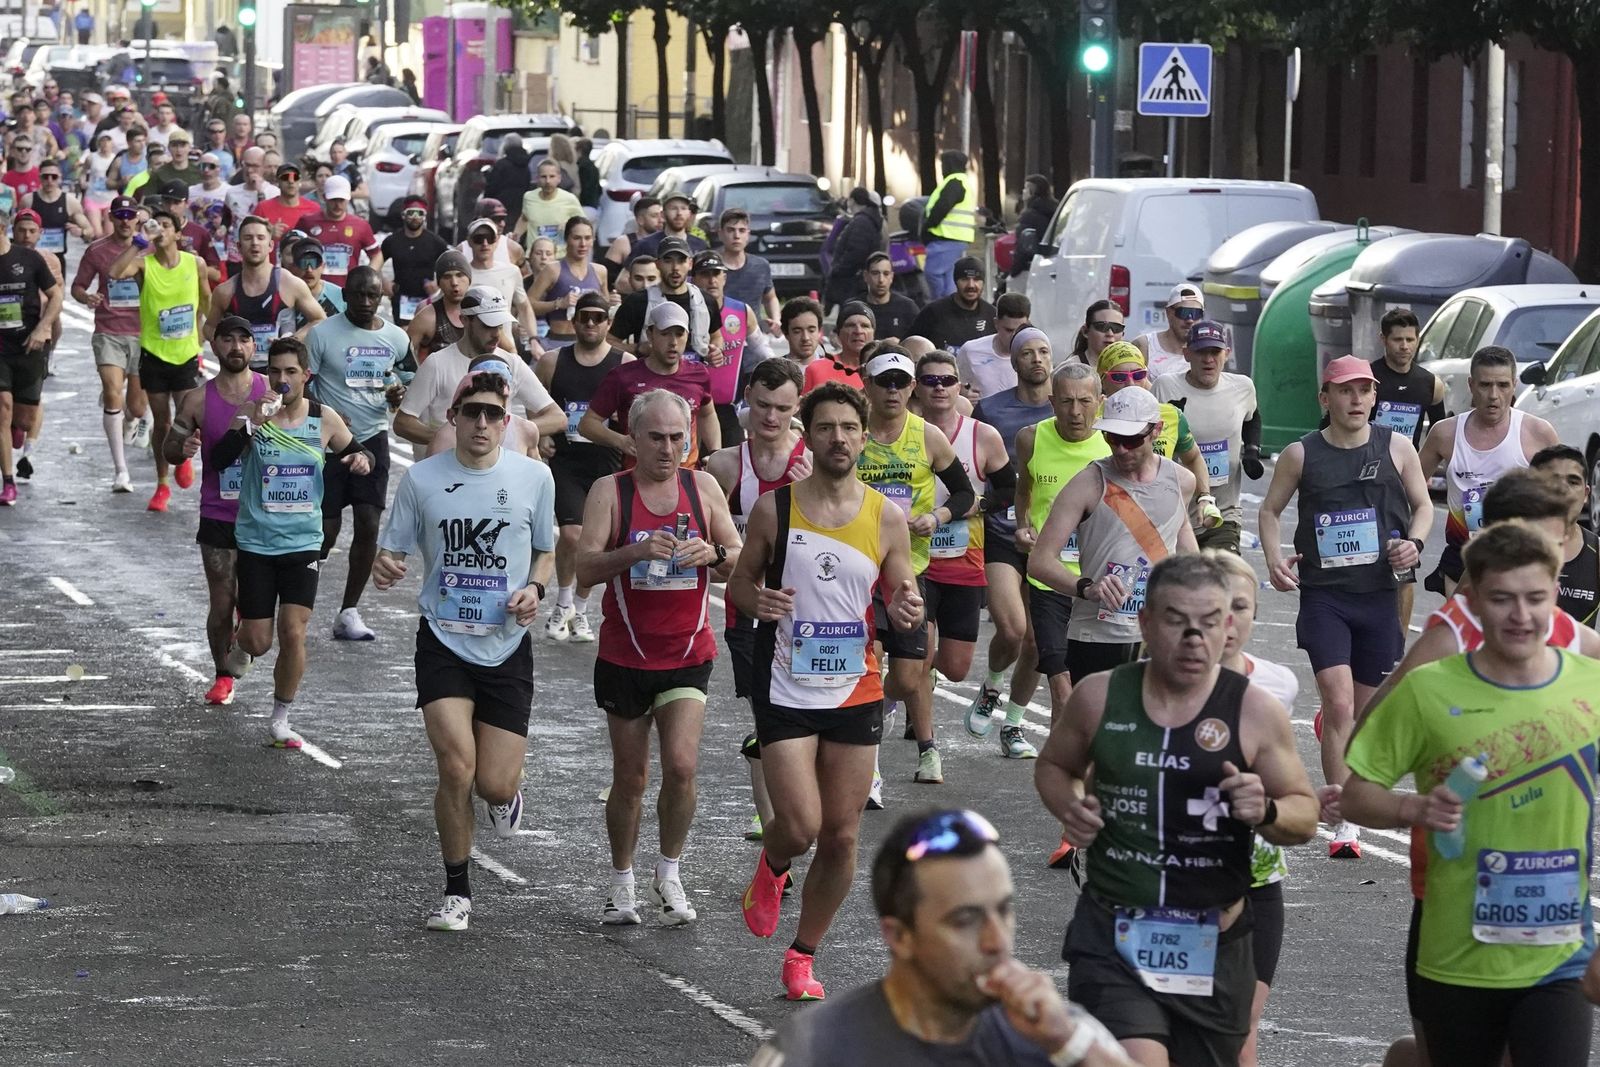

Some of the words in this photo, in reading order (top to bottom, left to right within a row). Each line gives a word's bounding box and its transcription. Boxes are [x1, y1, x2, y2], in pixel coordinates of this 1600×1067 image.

[360, 347, 387, 356] ZURICH
[346, 369, 375, 378] LONDON
[1392, 404, 1417, 412] ZURICH
[281, 466, 309, 475] ZURICH
[861, 470, 913, 482] CAMALEÓN
[268, 489, 308, 501] NICOLÁS
[1335, 512, 1369, 523] ZURICH
[1337, 530, 1355, 539] 5747
[1335, 540, 1361, 554] TOM
[444, 553, 507, 571] ELPENDO
[462, 577, 499, 588] ZURICH
[461, 595, 481, 605] 9604
[458, 607, 482, 621] EDU
[819, 626, 858, 635] ZURICH
[819, 645, 839, 655] 6021
[811, 658, 847, 671] FELIX
[1135, 751, 1191, 771] ELÍAS
[1514, 856, 1569, 870] ZURICH
[1476, 902, 1528, 923] GROS
[1534, 897, 1581, 923] JOSÉ
[1138, 949, 1189, 970] ELIAS
